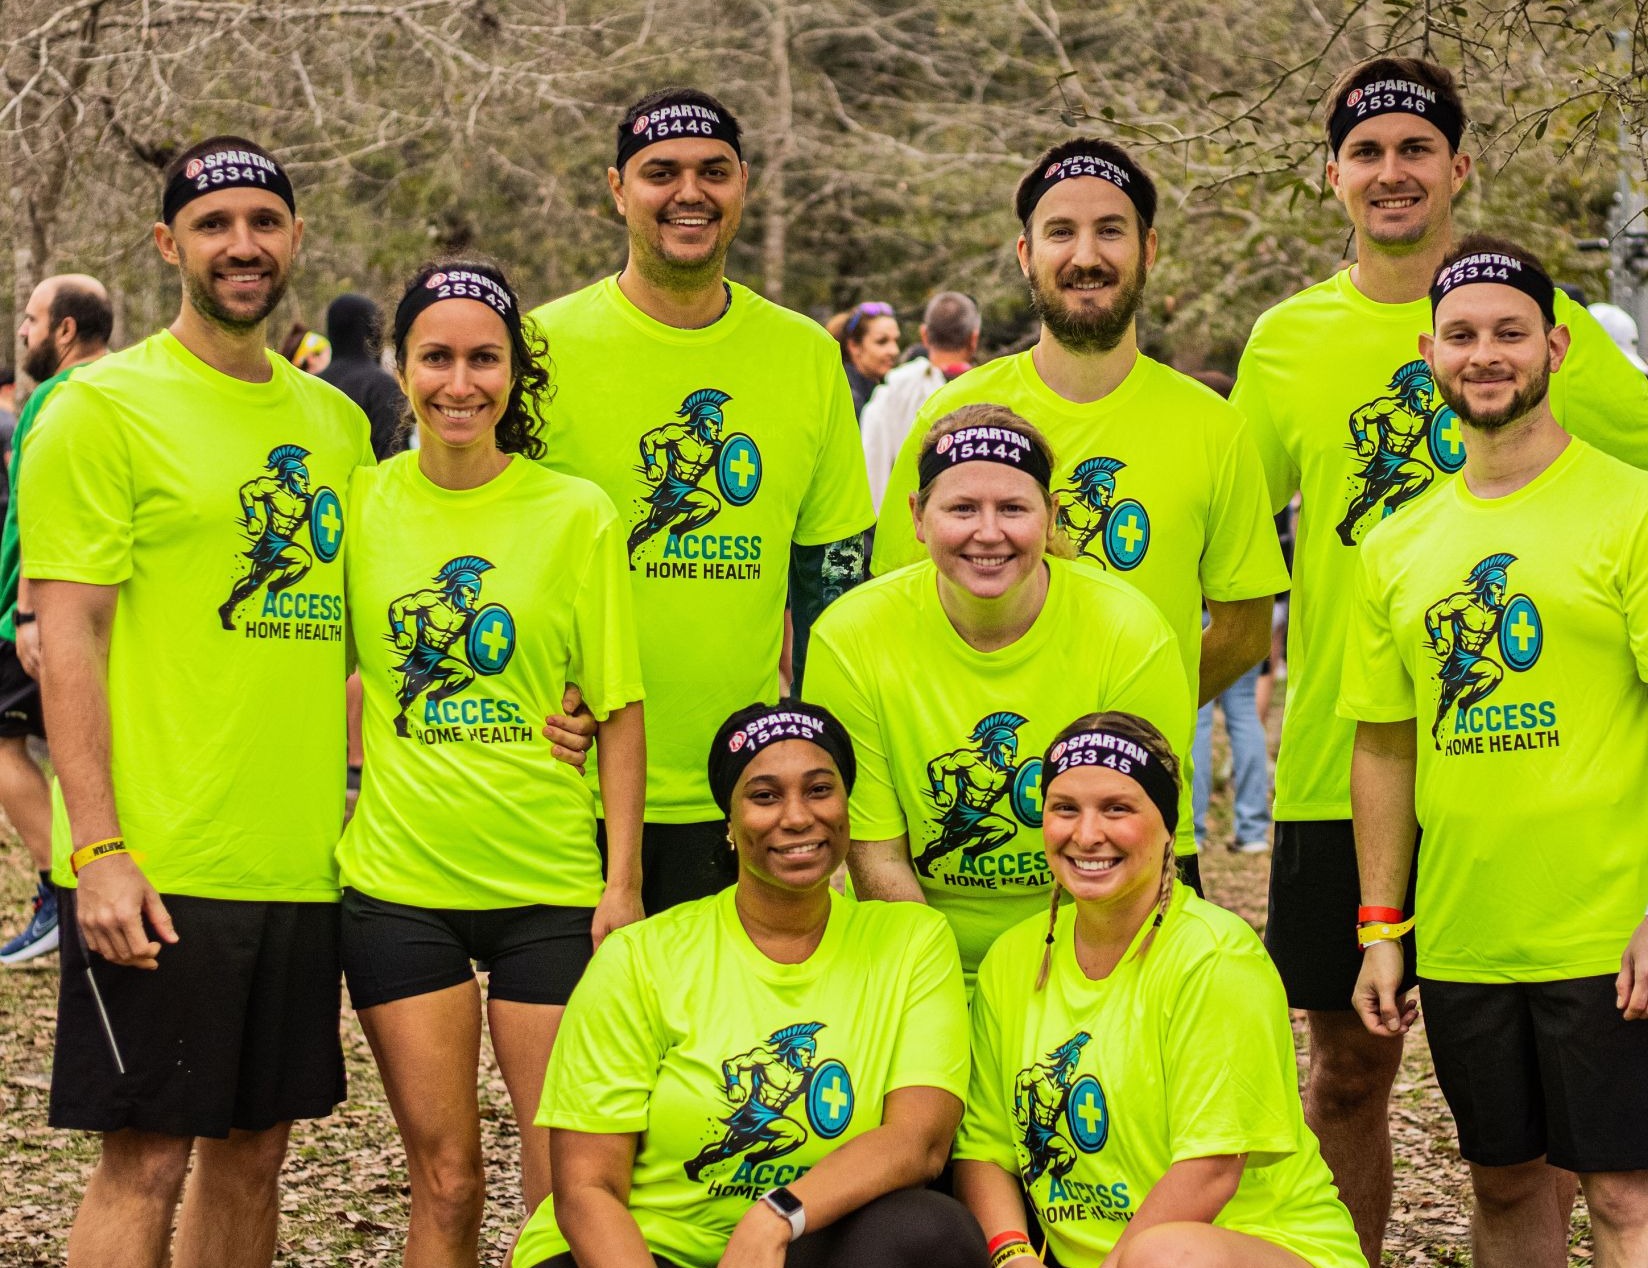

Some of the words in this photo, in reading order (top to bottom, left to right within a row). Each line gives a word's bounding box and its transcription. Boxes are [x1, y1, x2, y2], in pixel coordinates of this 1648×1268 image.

[1365, 79, 1436, 104] SPARTAN
[650, 104, 720, 124] SPARTAN
[645, 119, 712, 140] 15446
[204, 151, 277, 175] SPARTAN
[1062, 156, 1131, 183] SPARTAN
[197, 166, 266, 190] 25341
[1058, 164, 1123, 187] 15443
[1451, 253, 1522, 271] SPARTAN
[448, 271, 511, 308] SPARTAN
[1443, 266, 1509, 293] 25344
[954, 427, 1031, 452] SPARTAN
[949, 442, 1021, 463] 15444
[663, 534, 762, 560] ACCESS
[646, 562, 697, 579] HOME
[703, 563, 760, 580] HEALTH
[261, 591, 342, 621] ACCESS
[246, 621, 290, 639] HOME
[295, 622, 342, 641] HEALTH
[745, 712, 824, 736] SPARTAN
[1454, 700, 1556, 735] ACCESS
[747, 725, 813, 751] 15445
[1068, 733, 1149, 766] SPARTAN
[1445, 737, 1484, 756] HOME
[1489, 730, 1560, 752] HEALTH
[944, 873, 997, 890] HOME
[708, 1179, 765, 1201] HOME
